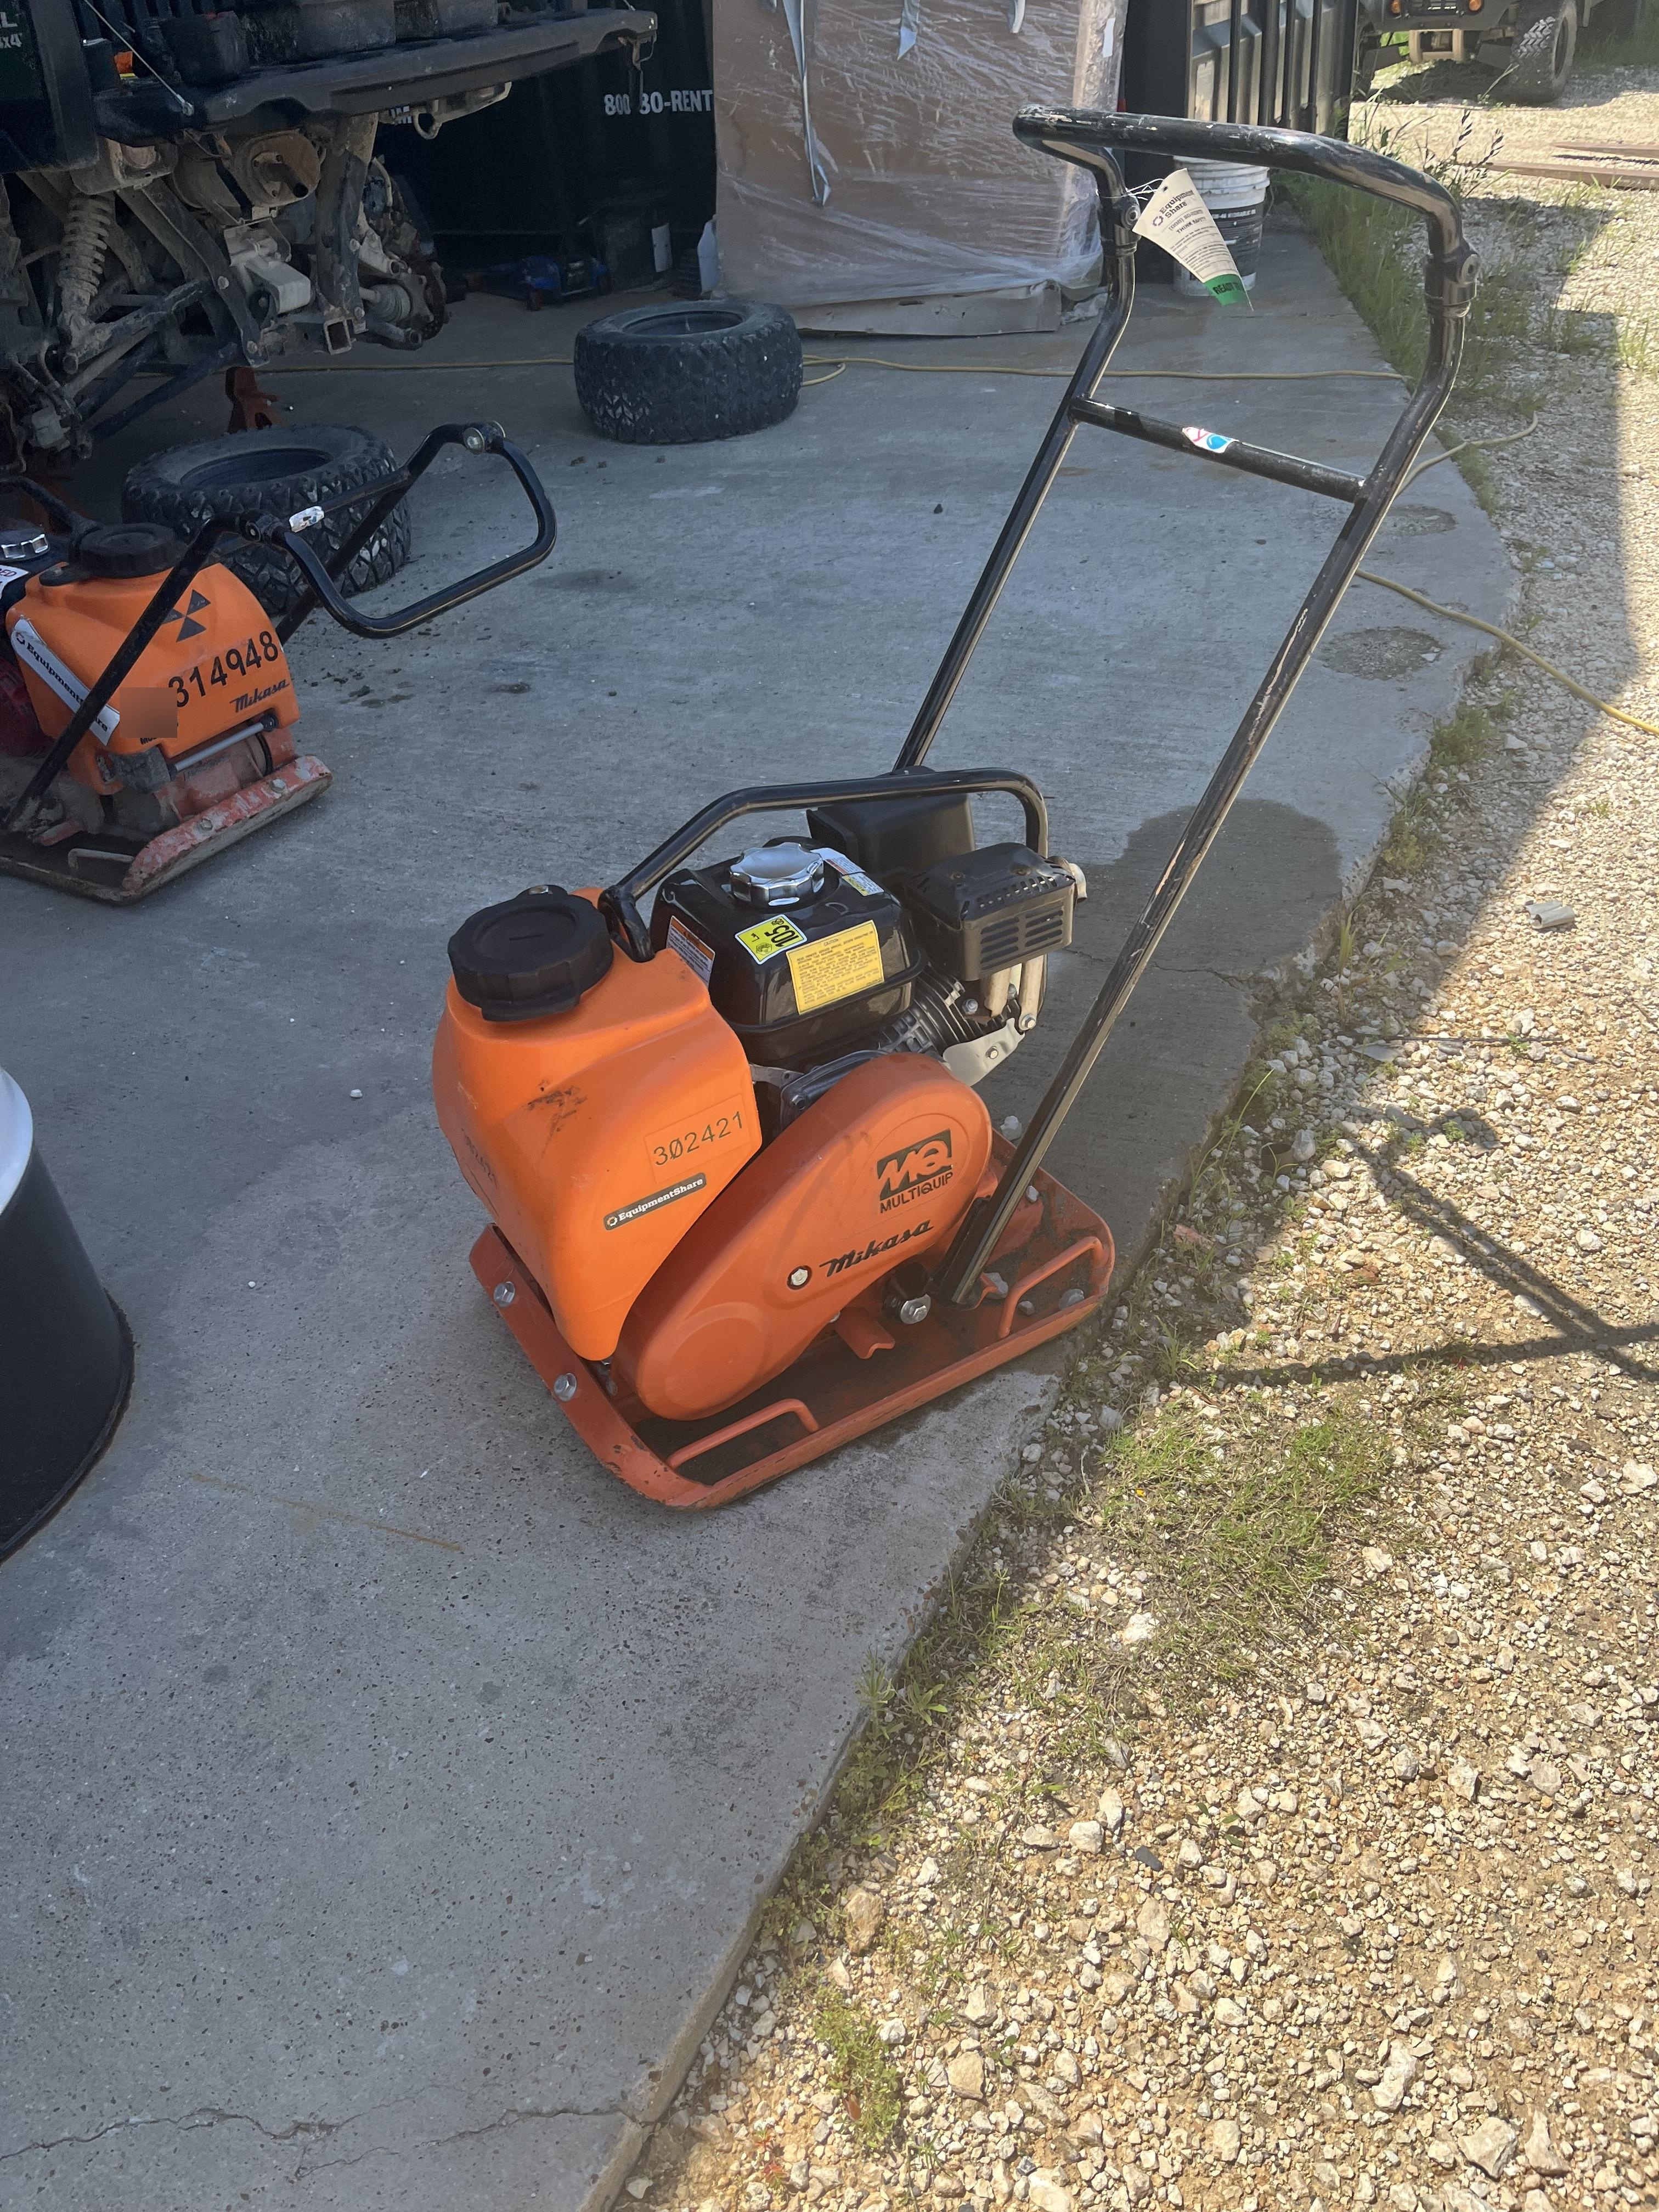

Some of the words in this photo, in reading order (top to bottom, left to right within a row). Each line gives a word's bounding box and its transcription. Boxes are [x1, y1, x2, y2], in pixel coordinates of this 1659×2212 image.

[1165, 201, 1187, 218] Share
[168, 631, 278, 708] 314948
[229, 678, 290, 713] Mikasa
[764, 925, 799, 947] 105
[653, 1111, 743, 1166] 302421
[618, 1178, 704, 1222] EquipmentShare
[880, 1171, 953, 1214] MULTIQUIP
[819, 1219, 934, 1278] Mikasa
